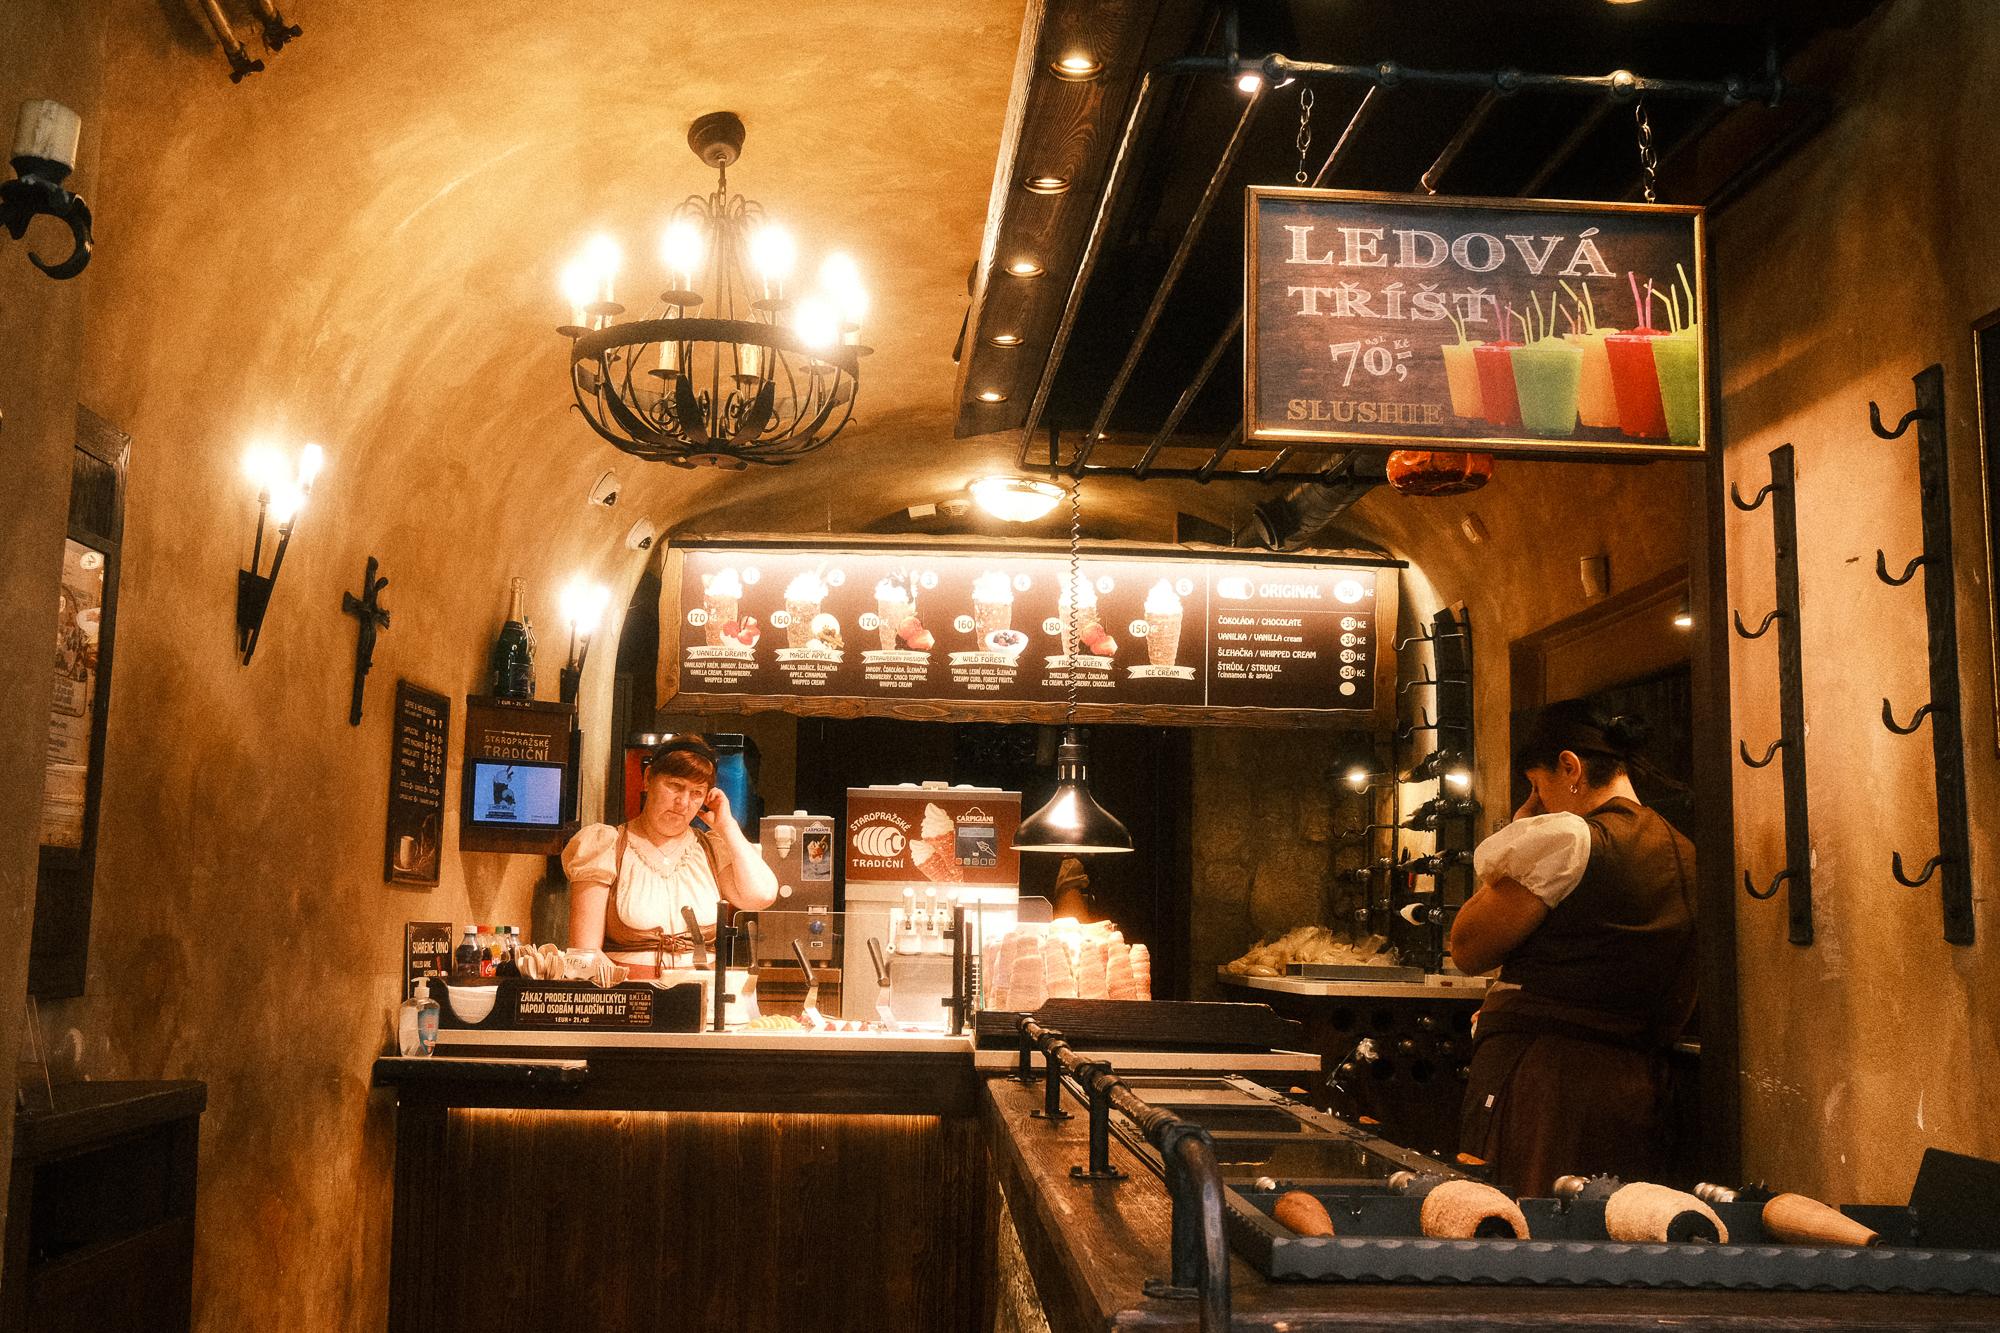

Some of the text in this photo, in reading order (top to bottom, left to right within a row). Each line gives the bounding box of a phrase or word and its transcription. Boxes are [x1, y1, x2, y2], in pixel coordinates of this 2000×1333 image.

[1284, 224, 1616, 278] LEDOVÁ
[1288, 281, 1496, 323] TŘÍŠŤ
[1393, 338, 1410, 349] Kč
[1287, 398, 1444, 426] SLUSHIE
[1259, 584, 1321, 599] ORIGINAL
[691, 614, 706, 622] 170
[774, 616, 789, 624] 160
[862, 618, 877, 627] 170
[1218, 615, 1254, 625] ČOKOLÁDA
[1261, 618, 1302, 627] CHOCOLATE
[958, 620, 973, 629] 160
[1133, 625, 1147, 634] 150
[1357, 620, 1367, 629] Kč
[1217, 633, 1247, 641] VANILKA
[1253, 634, 1282, 642] VANILLA
[1341, 635, 1367, 645] +30 Kč
[1217, 647, 1253, 657] ŠLEHAČKA
[1259, 650, 1291, 659] WHIPPED
[1292, 651, 1317, 659] CREAM
[1341, 652, 1366, 661] +30 Kč
[1251, 664, 1282, 672] STRUDEL
[1340, 668, 1366, 677] +50 Kč
[485, 735, 550, 748] STAROPRAŽSKÉ
[484, 745, 549, 761] TRADIČNÍ
[850, 811, 912, 832] STAROPRAŽSKÉ
[852, 858, 904, 868] TRADIČNÍ
[435, 938, 449, 954] VÍNO
[520, 990, 543, 1003] ZÁKAZ
[544, 992, 573, 1003] PRODEJE
[573, 992, 627, 1004] ALKOHOLICKÝCH
[520, 1002, 546, 1014] NÁPOJŮ
[546, 1003, 574, 1014] OSOBÁM
[575, 1003, 605, 1015] MLADŠÍM
[606, 1005, 614, 1015] 18
[614, 1005, 627, 1015] LET
